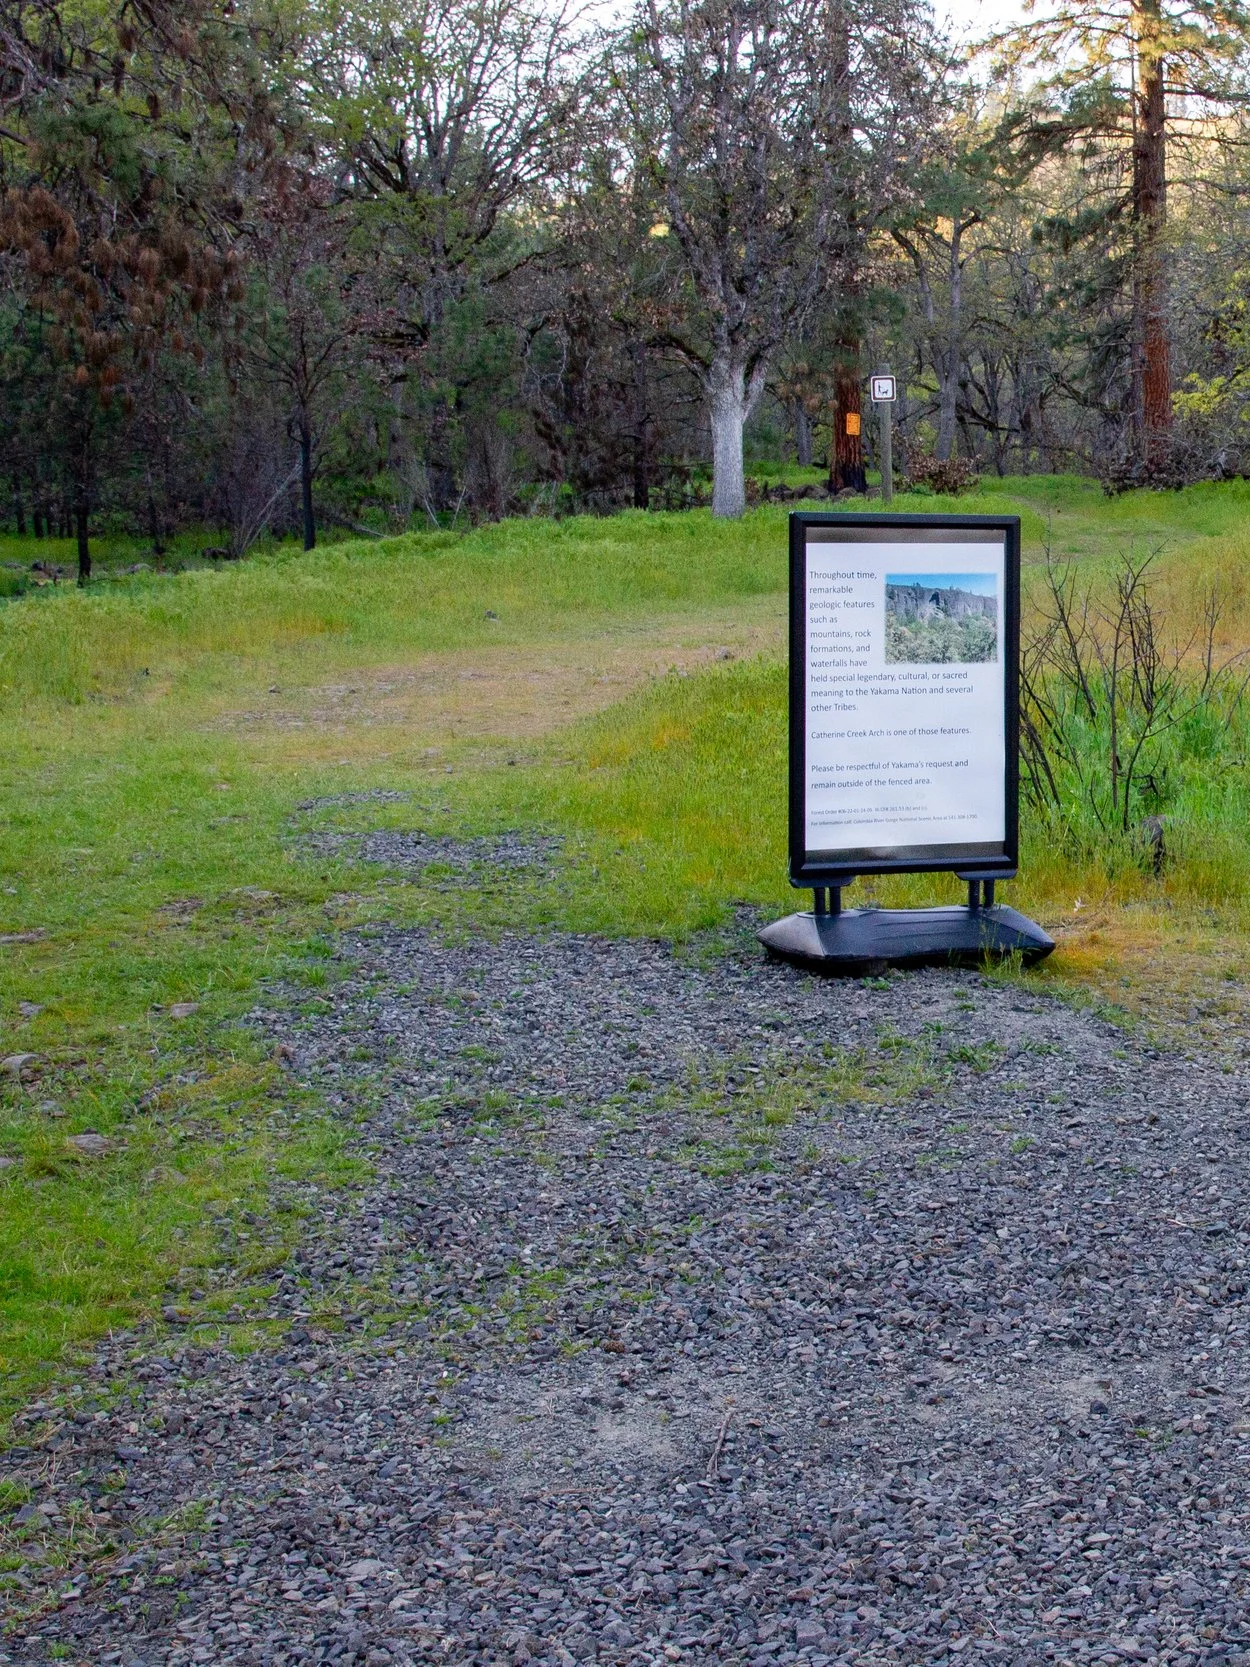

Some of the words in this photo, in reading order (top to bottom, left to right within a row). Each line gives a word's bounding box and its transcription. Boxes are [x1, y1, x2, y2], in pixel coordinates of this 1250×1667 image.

[809, 571, 854, 580] Throughout
[857, 571, 877, 579] time,
[809, 601, 842, 610] geologic
[810, 631, 853, 639] mountains,
[810, 645, 854, 653] formations,
[830, 674, 855, 683] special
[857, 673, 897, 683] legendary,
[811, 689, 844, 698] meaning
[871, 687, 899, 695] Yakama
[811, 731, 845, 739] Catherine
[918, 727, 938, 735] those
[847, 762, 880, 772] respectful
[892, 761, 924, 769] Yakama's
[926, 760, 953, 769] request
[955, 759, 968, 767] and
[811, 781, 836, 789] remain
[838, 780, 863, 788] outside
